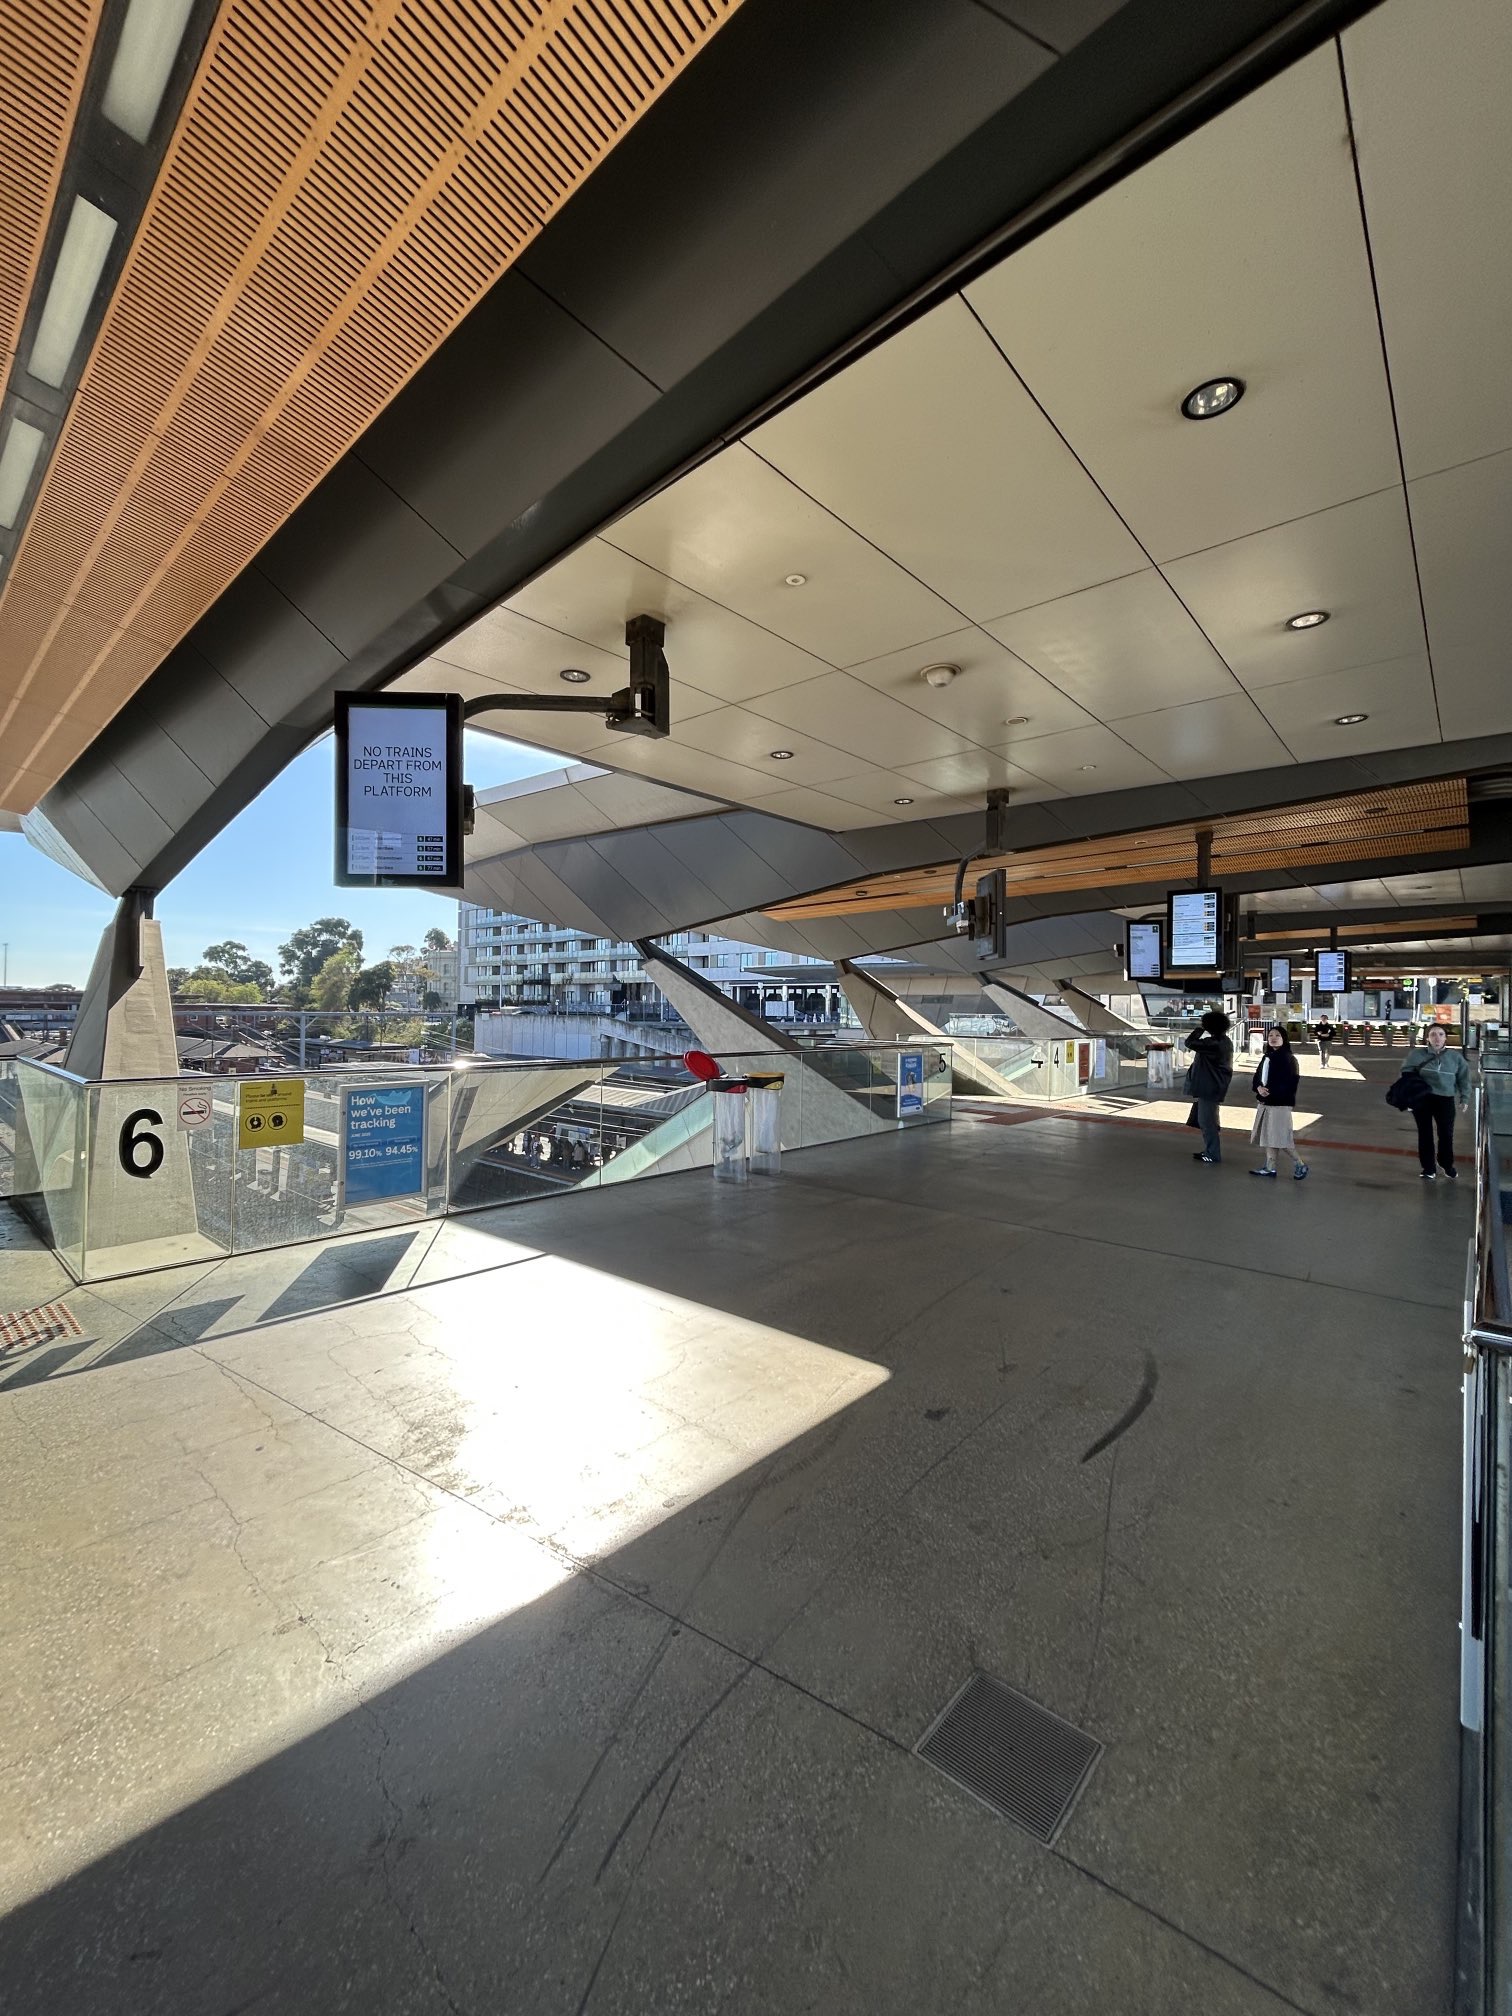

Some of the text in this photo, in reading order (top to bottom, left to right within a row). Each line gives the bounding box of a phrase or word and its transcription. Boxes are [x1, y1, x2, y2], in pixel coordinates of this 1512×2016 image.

[363, 746, 432, 758] NO TRAINS
[353, 759, 442, 771] DEPART FROM
[383, 772, 413, 784] THIS
[364, 785, 432, 797] PLATFORM
[938, 1052, 947, 1073] 5
[1053, 1046, 1060, 1069] 4
[351, 1095, 376, 1106] How
[350, 1105, 411, 1118] we've been
[350, 1117, 396, 1130] tracking
[118, 1108, 165, 1179] 6
[348, 1148, 383, 1160] 99.10%
[385, 1144, 419, 1156] 94.45%
